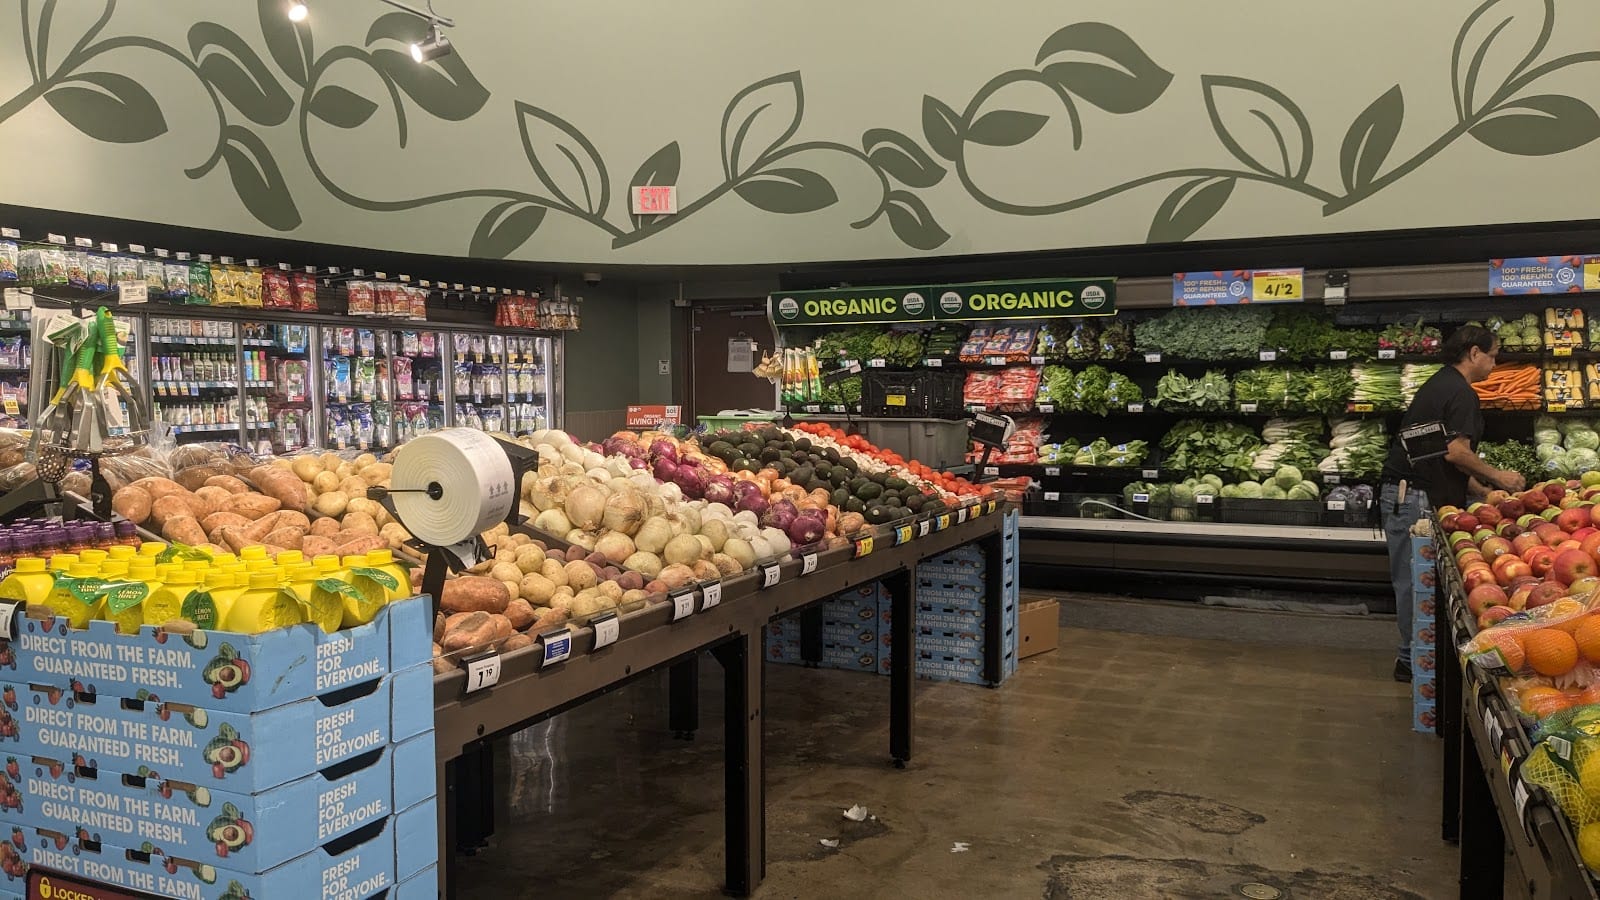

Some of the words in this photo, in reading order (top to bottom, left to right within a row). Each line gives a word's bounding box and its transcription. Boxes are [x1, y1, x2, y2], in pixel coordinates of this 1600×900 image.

[640, 187, 670, 210] EXIT
[804, 297, 897, 316] ORGANIC
[969, 290, 1073, 311] ORGANIC
[21, 634, 66, 655] DIRECT
[70, 640, 113, 660] FROM
[116, 645, 144, 663] THE
[148, 648, 196, 669] FARM.
[317, 638, 354, 659] FRESH
[33, 656, 127, 682] GUARANTEED
[131, 667, 182, 688] FRESH.
[317, 656, 342, 674] FOR
[25, 706, 73, 728] DIRECT
[77, 714, 117, 735] FROM
[121, 721, 147, 740] THE
[152, 725, 197, 748] FARM.
[316, 709, 354, 734] FRESH
[38, 728, 130, 758] GUARANTEED
[135, 744, 184, 767] FRESH.
[316, 729, 342, 749] FOR
[28, 779, 75, 802] DIRECT
[79, 788, 119, 812] FROM
[123, 797, 149, 817] THE
[154, 803, 200, 826] FARM.
[320, 781, 356, 808] FRESH
[42, 802, 133, 834] GUARANTEED
[138, 820, 187, 844] FRESH.
[319, 802, 344, 824] FOR
[33, 848, 79, 873] DIRECT
[84, 862, 124, 884] FROM
[128, 870, 154, 890] THE
[158, 877, 206, 900] FARM.
[322, 856, 360, 884] FRESH
[322, 877, 348, 900] FOR
